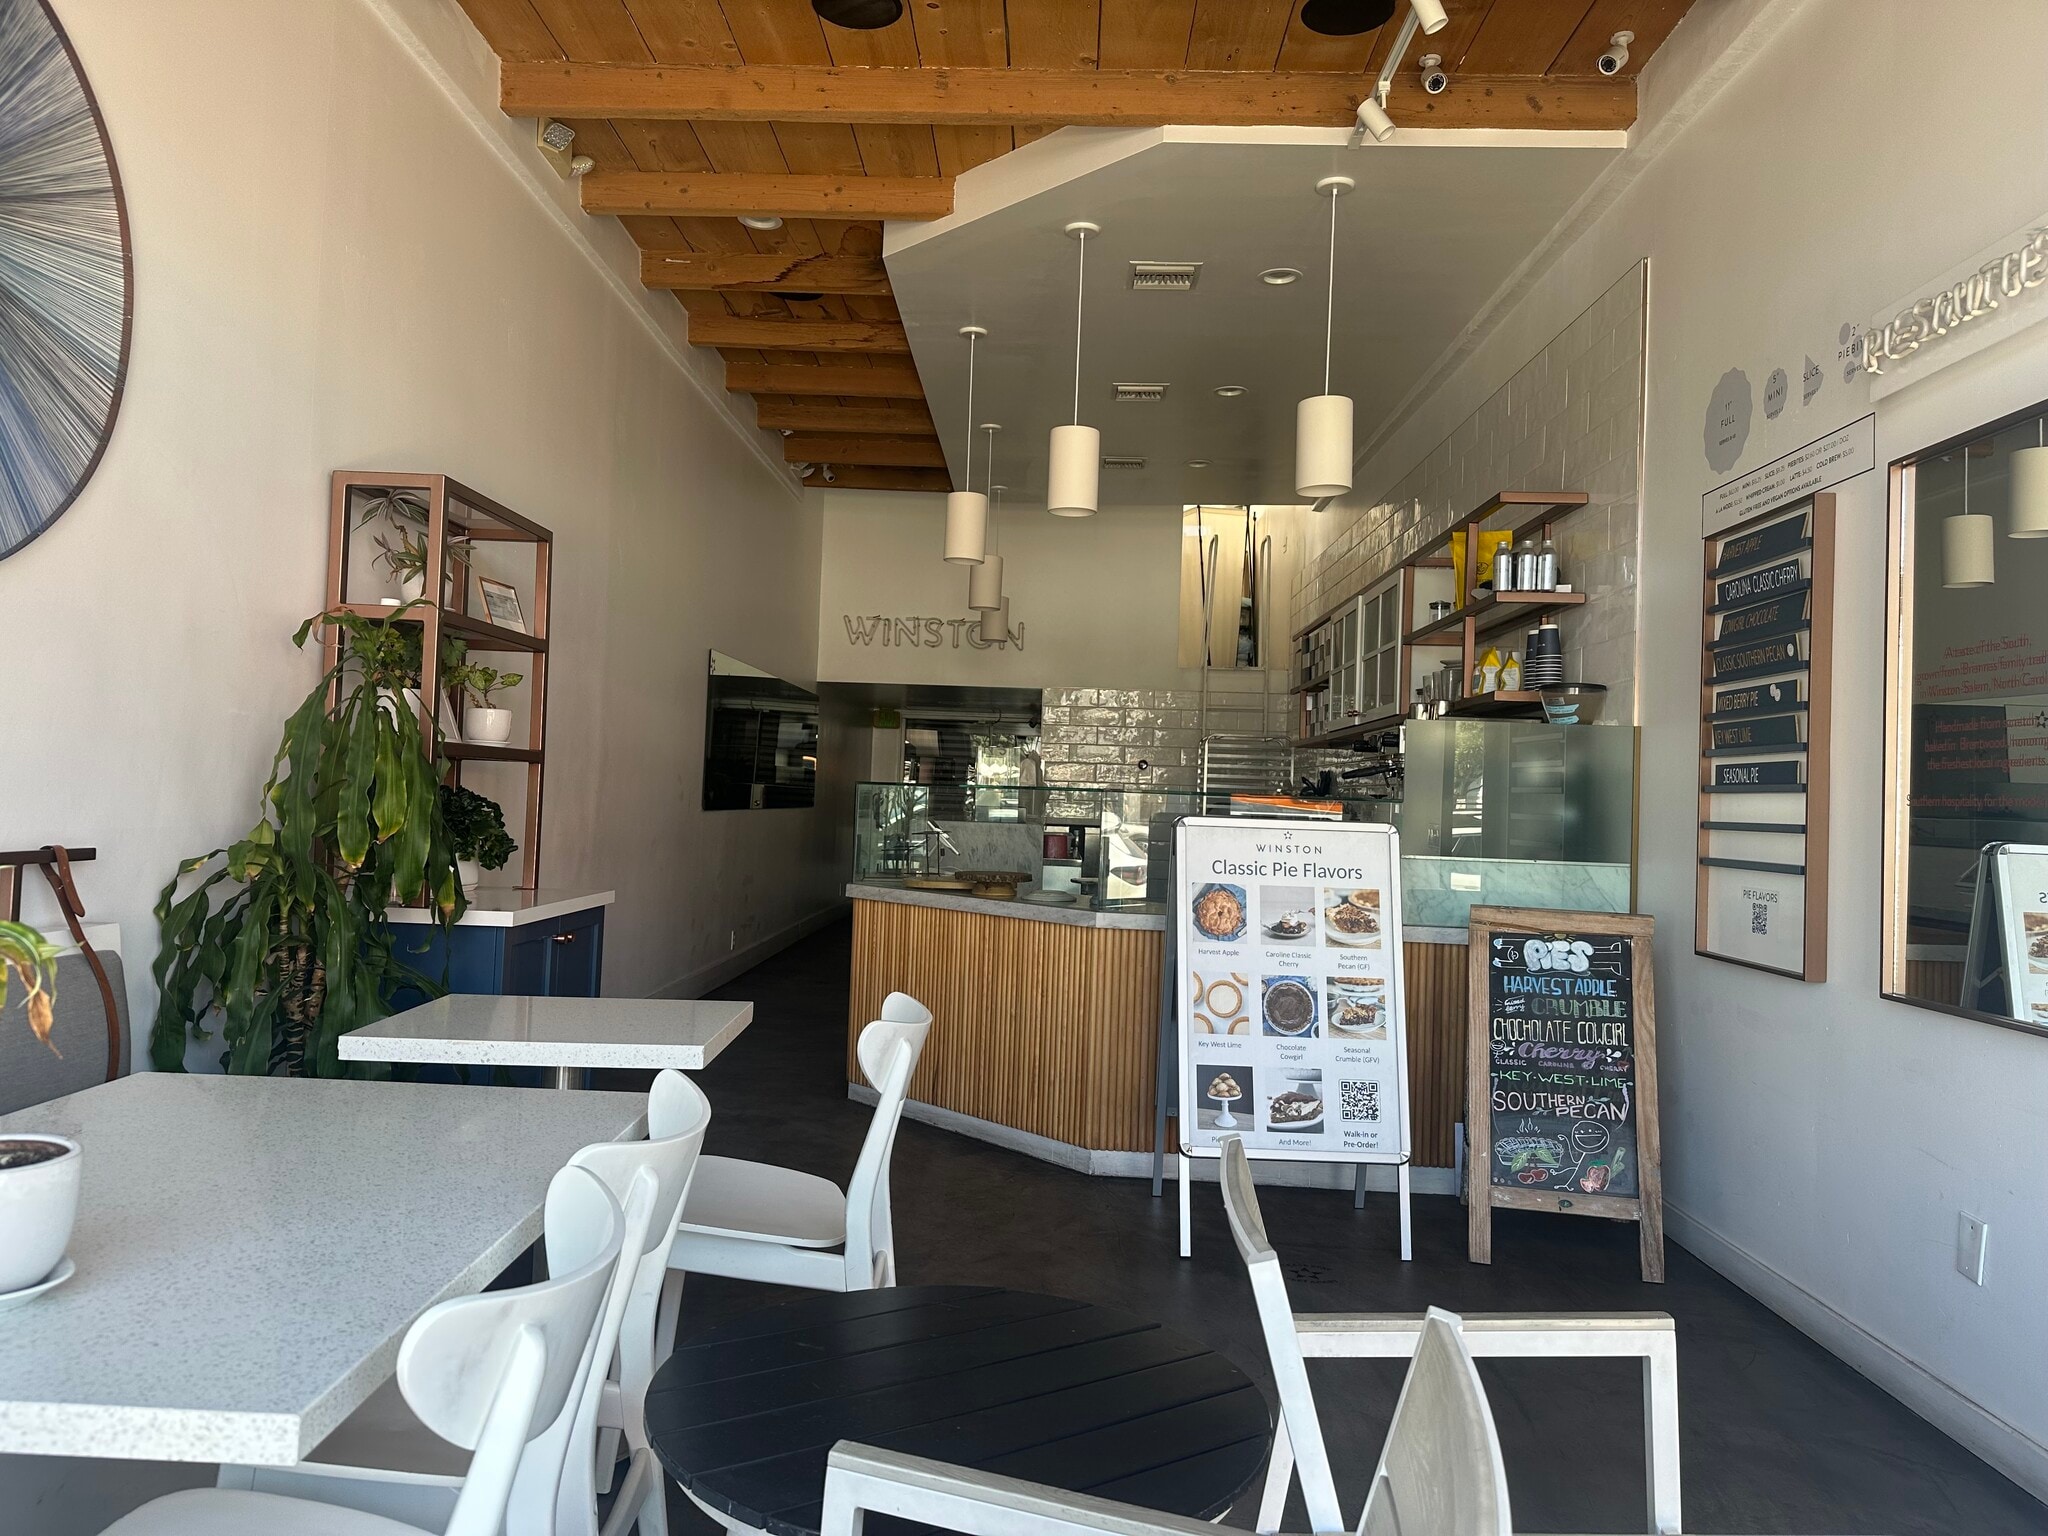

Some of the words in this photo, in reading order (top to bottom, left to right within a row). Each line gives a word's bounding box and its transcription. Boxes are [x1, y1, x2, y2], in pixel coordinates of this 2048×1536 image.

[1803, 364, 1820, 383] SLICE
[1767, 386, 1783, 404] MINI
[1720, 414, 1736, 428] FULL
[1816, 458, 1828, 470] COLD
[1738, 505, 1752, 517] GLUTEN
[1753, 500, 1762, 512] FREE
[1762, 498, 1770, 508] AND
[1770, 492, 1784, 504] VEGAN
[1784, 484, 1801, 499] OPTIONS
[1801, 475, 1822, 492] AVAILABLE
[1722, 540, 1746, 561] HARVEST
[1744, 534, 1762, 554] APPLE
[1725, 577, 1751, 602] CAROLINA
[1753, 570, 1774, 594] CLASSIC
[1774, 564, 1798, 587] CHERRY
[1722, 614, 1746, 635] COWGIRL
[1744, 605, 1778, 628] CHOCOLATE
[843, 614, 1026, 652] WINSTON
[1716, 652, 1738, 673] CLASSIC
[1737, 648, 1766, 668] SOUTHERN
[1766, 644, 1786, 662] PECAN
[1717, 693, 1733, 712] MIXED
[1734, 692, 1749, 709] BERRY
[1749, 692, 1759, 707] PIE
[1714, 728, 1725, 744] KEY
[1724, 727, 1739, 744] WEST
[1739, 726, 1752, 743] LIME
[1723, 767, 1749, 784] SEASONAL
[1750, 766, 1759, 784] PIE
[1256, 843, 1322, 856] WINSTON
[1211, 858, 1268, 878] Classic
[1272, 860, 1298, 878] Pie
[1304, 862, 1363, 880] Flavors
[1742, 888, 1752, 900] PIE
[1752, 890, 1778, 904] FLAVORS
[1198, 948, 1220, 956] Harvest
[1222, 948, 1240, 958] Apple
[1265, 950, 1290, 959] Caroline
[1291, 951, 1312, 960] Classic
[1340, 953, 1368, 962] Southern
[1278, 960, 1299, 970] Cherry
[1337, 962, 1356, 970] Pecan
[1357, 962, 1371, 972] (GF)
[1503, 975, 1574, 996] HARVEST
[1574, 978, 1618, 998] APPLE
[1531, 998, 1628, 1019] CRUMBLE
[1493, 1017, 1573, 1044] CHOCHOLATE
[1577, 1021, 1629, 1047] COWGIRL
[1198, 1040, 1210, 1050] Key
[1210, 1040, 1226, 1049] West
[1227, 1041, 1242, 1050] Lime
[1276, 1043, 1307, 1052] Chocolate
[1343, 1046, 1371, 1054] Seasonal
[1280, 1052, 1304, 1062] Cowgirl
[1335, 1055, 1361, 1064] Crumble
[1362, 1055, 1380, 1064] (GFV)
[1517, 1041, 1606, 1070] Cherry
[1496, 1058, 1527, 1066] CLASSIC
[1600, 1065, 1629, 1073] CHERRY
[1499, 1070, 1534, 1082] KEY
[1538, 1073, 1586, 1086] WEST
[1591, 1076, 1627, 1089] LIME
[1493, 1090, 1586, 1112] SOUTHERN
[1556, 1101, 1630, 1122] PECAN
[1278, 1138, 1292, 1146] And
[1293, 1138, 1312, 1147] More!
[1344, 1130, 1368, 1139] Walk-in
[1370, 1131, 1378, 1139] or
[1343, 1140, 1379, 1149] Pre-Order!
